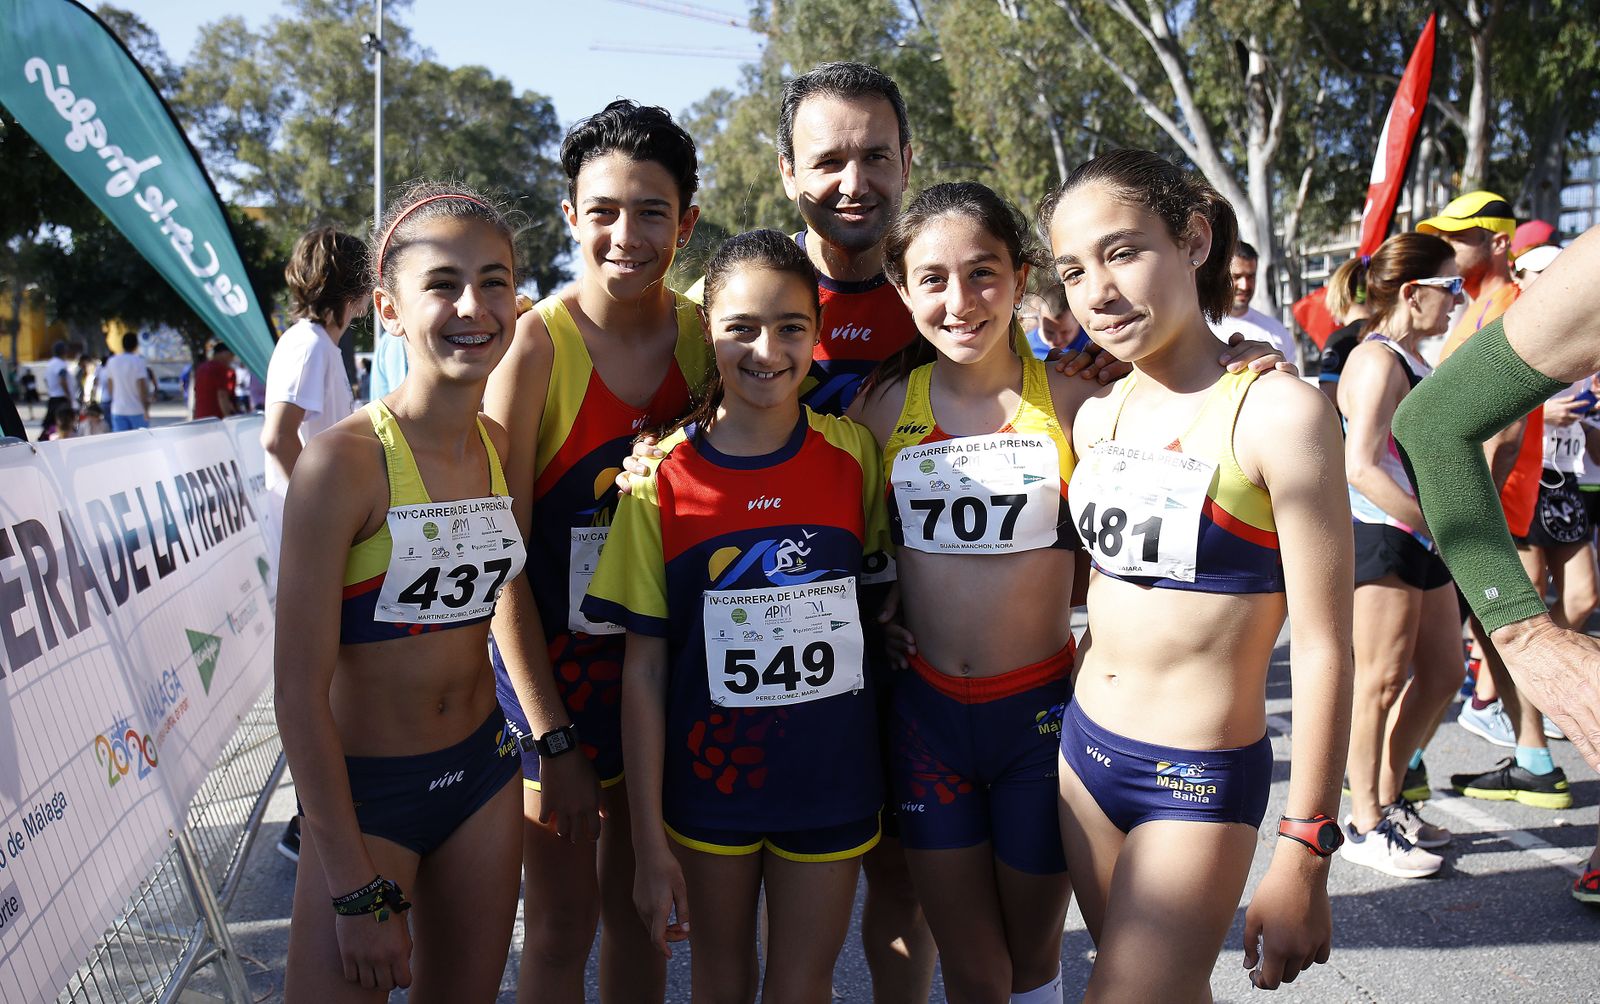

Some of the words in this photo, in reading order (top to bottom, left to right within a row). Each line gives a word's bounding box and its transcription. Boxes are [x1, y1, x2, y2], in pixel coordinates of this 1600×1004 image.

[913, 445, 963, 458] CARRERA
[966, 443, 980, 452] DE
[984, 441, 997, 450] LA
[1000, 440, 1044, 448] PRENSA
[1127, 449, 1140, 459] DE
[1142, 453, 1154, 461] LA
[397, 511, 408, 519] IV
[411, 506, 458, 519] CARRERA
[458, 505, 468, 514] DE
[470, 503, 481, 513] LA
[481, 501, 508, 511] PRENSA
[910, 494, 1027, 541] 707
[452, 518, 470, 533] APM
[1079, 502, 1162, 563] 481
[0, 509, 111, 681] ERA
[85, 491, 151, 607] DE
[136, 481, 190, 579] LA
[174, 460, 258, 557] PRENSA
[398, 557, 512, 610] 437
[722, 594, 774, 605] CARRERA
[778, 591, 791, 601] DE
[793, 590, 805, 599] LA
[807, 585, 846, 597] PRENSA
[418, 613, 449, 621] MARTINEZ
[765, 604, 791, 619] APM
[723, 641, 835, 694] 549
[801, 688, 820, 696] MARIA
[95, 729, 158, 788] 2020
[1156, 775, 1217, 797] Málaga
[7, 832, 25, 858] de
[23, 791, 68, 842] Málaga
